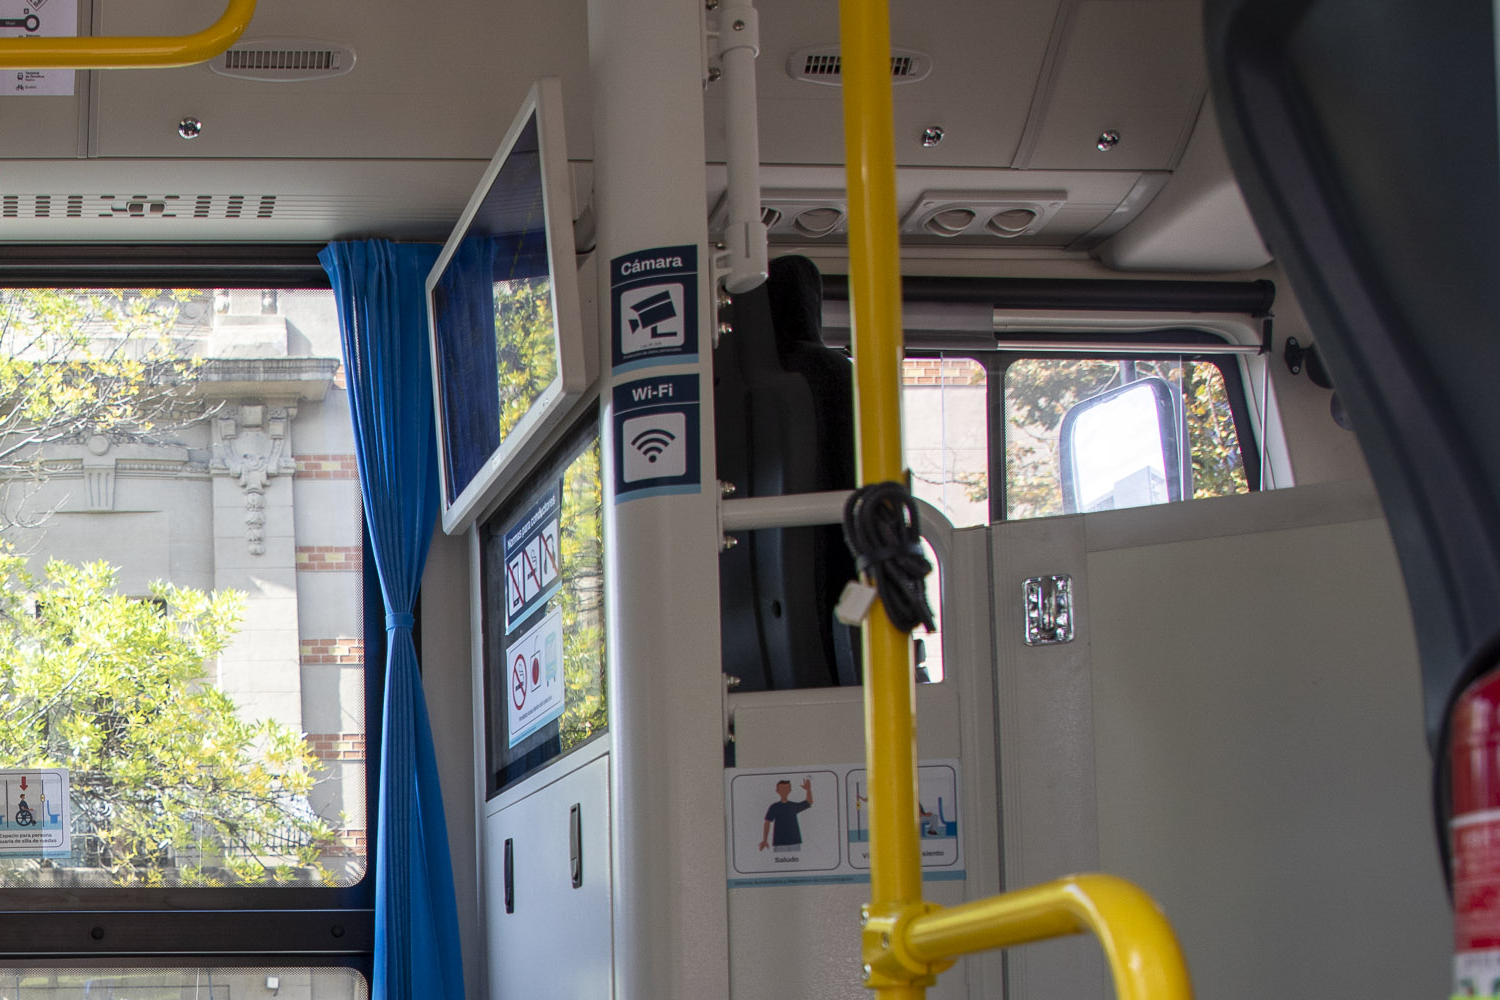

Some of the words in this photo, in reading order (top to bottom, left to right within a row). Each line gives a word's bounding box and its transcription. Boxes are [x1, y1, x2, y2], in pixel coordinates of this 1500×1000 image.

[620, 256, 683, 276] Cámara
[632, 384, 674, 402] Wi-Fi
[508, 530, 522, 550] Normas
[522, 521, 530, 538] para
[530, 496, 556, 526] conductores
